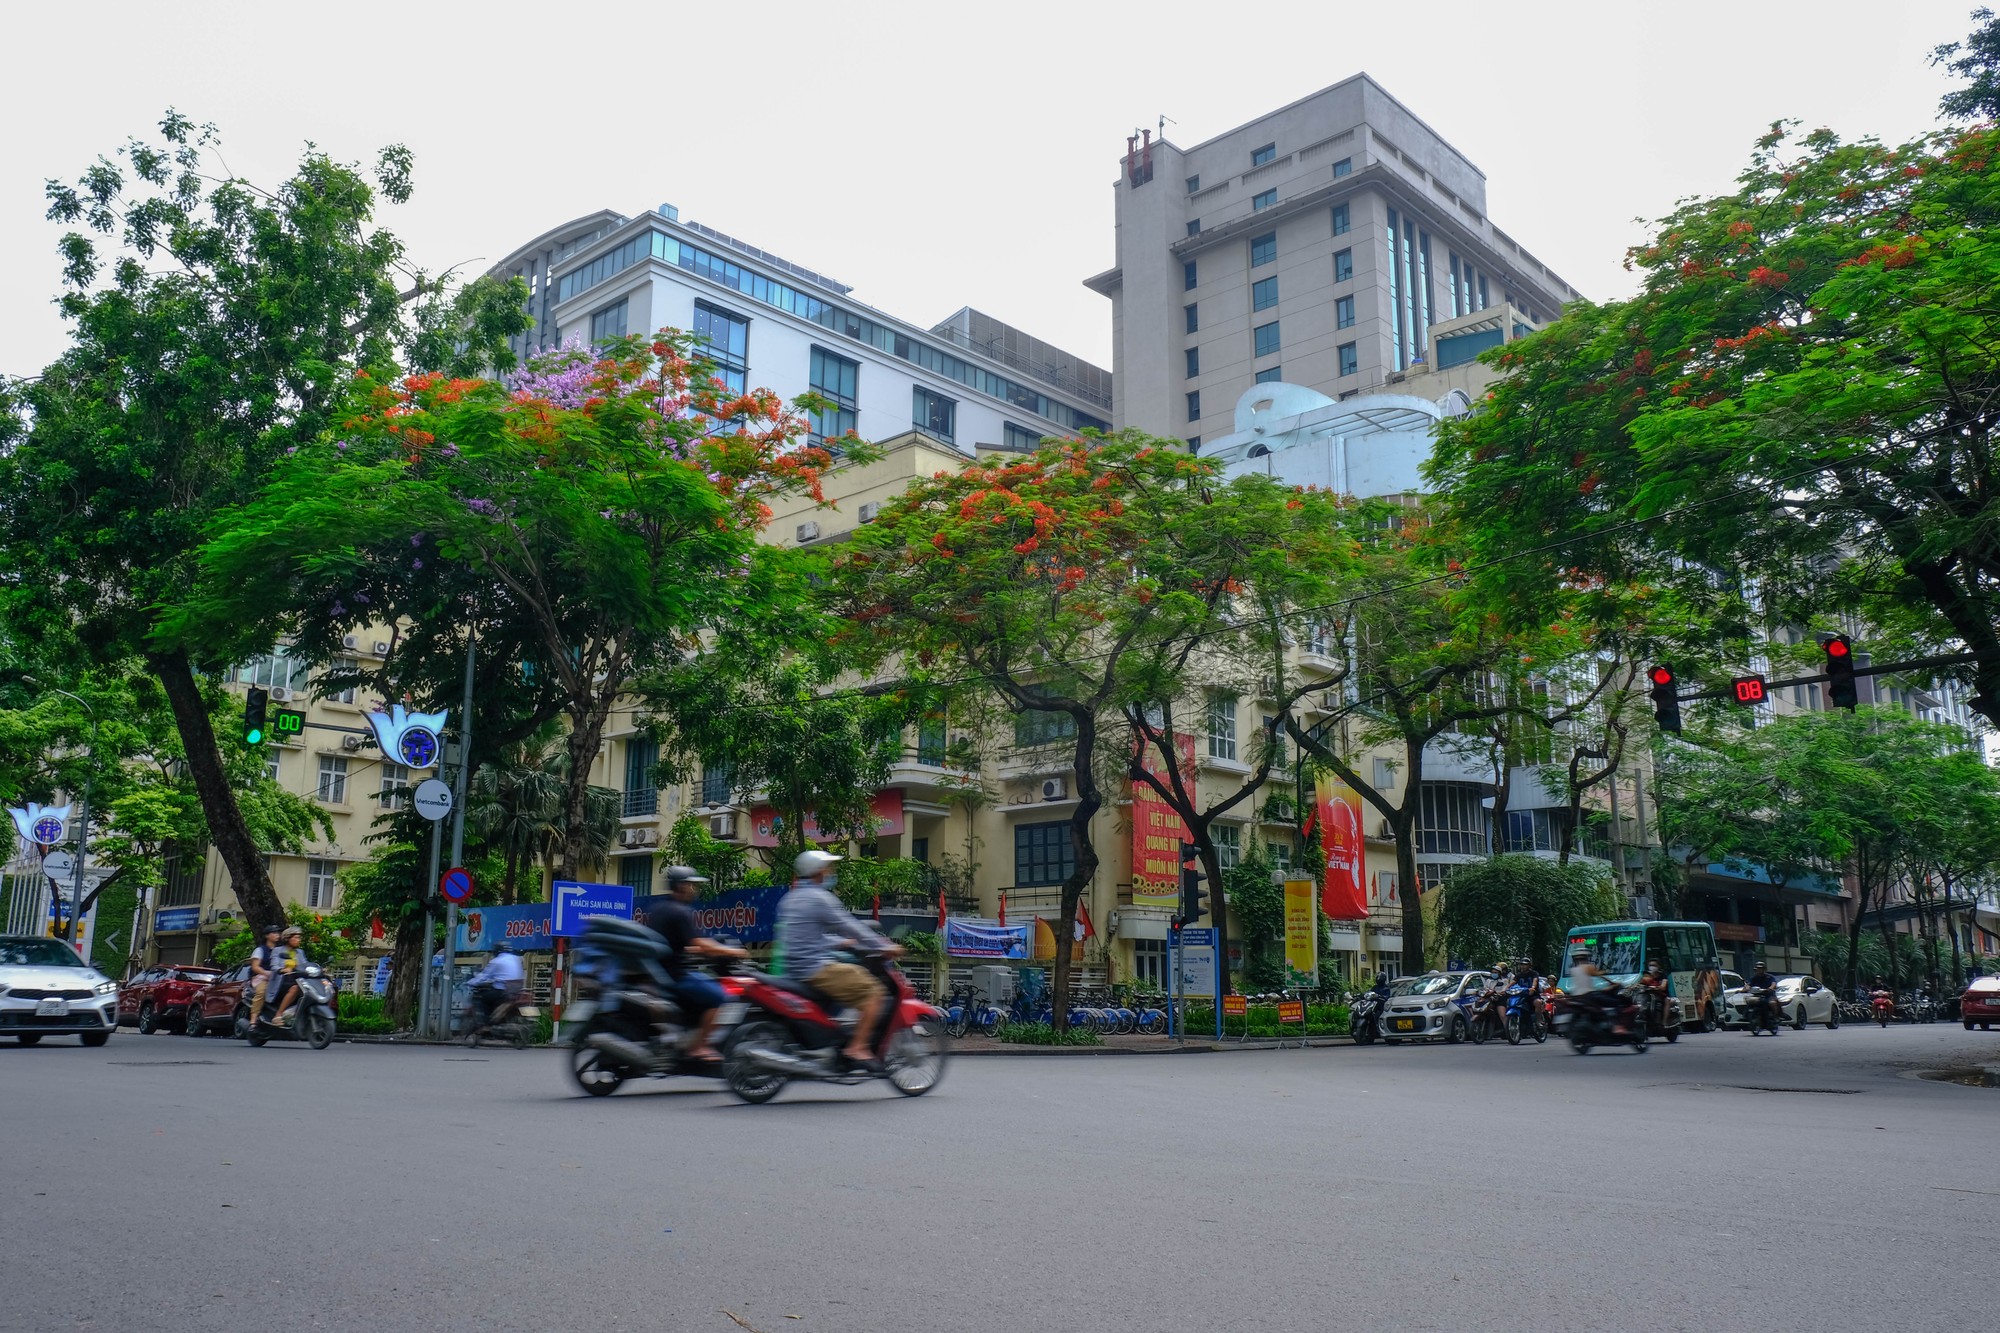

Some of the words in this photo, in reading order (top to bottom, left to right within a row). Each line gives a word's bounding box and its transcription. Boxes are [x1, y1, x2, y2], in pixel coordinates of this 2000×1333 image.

[1737, 681, 1762, 700] 08
[279, 714, 300, 731] 00
[416, 798, 450, 807] Vietcombank
[1150, 810, 1163, 830] VIỆT
[1146, 835, 1168, 851] QUANG
[1170, 837, 1179, 852] VIN
[1146, 857, 1166, 874] MUÔN
[570, 898, 588, 908] KHÁCH
[590, 901, 601, 909] SẠN
[602, 900, 612, 909] HÒA
[614, 900, 627, 910] BÌNH
[505, 920, 534, 937] 2024
[692, 900, 756, 934] NGUYỆN
